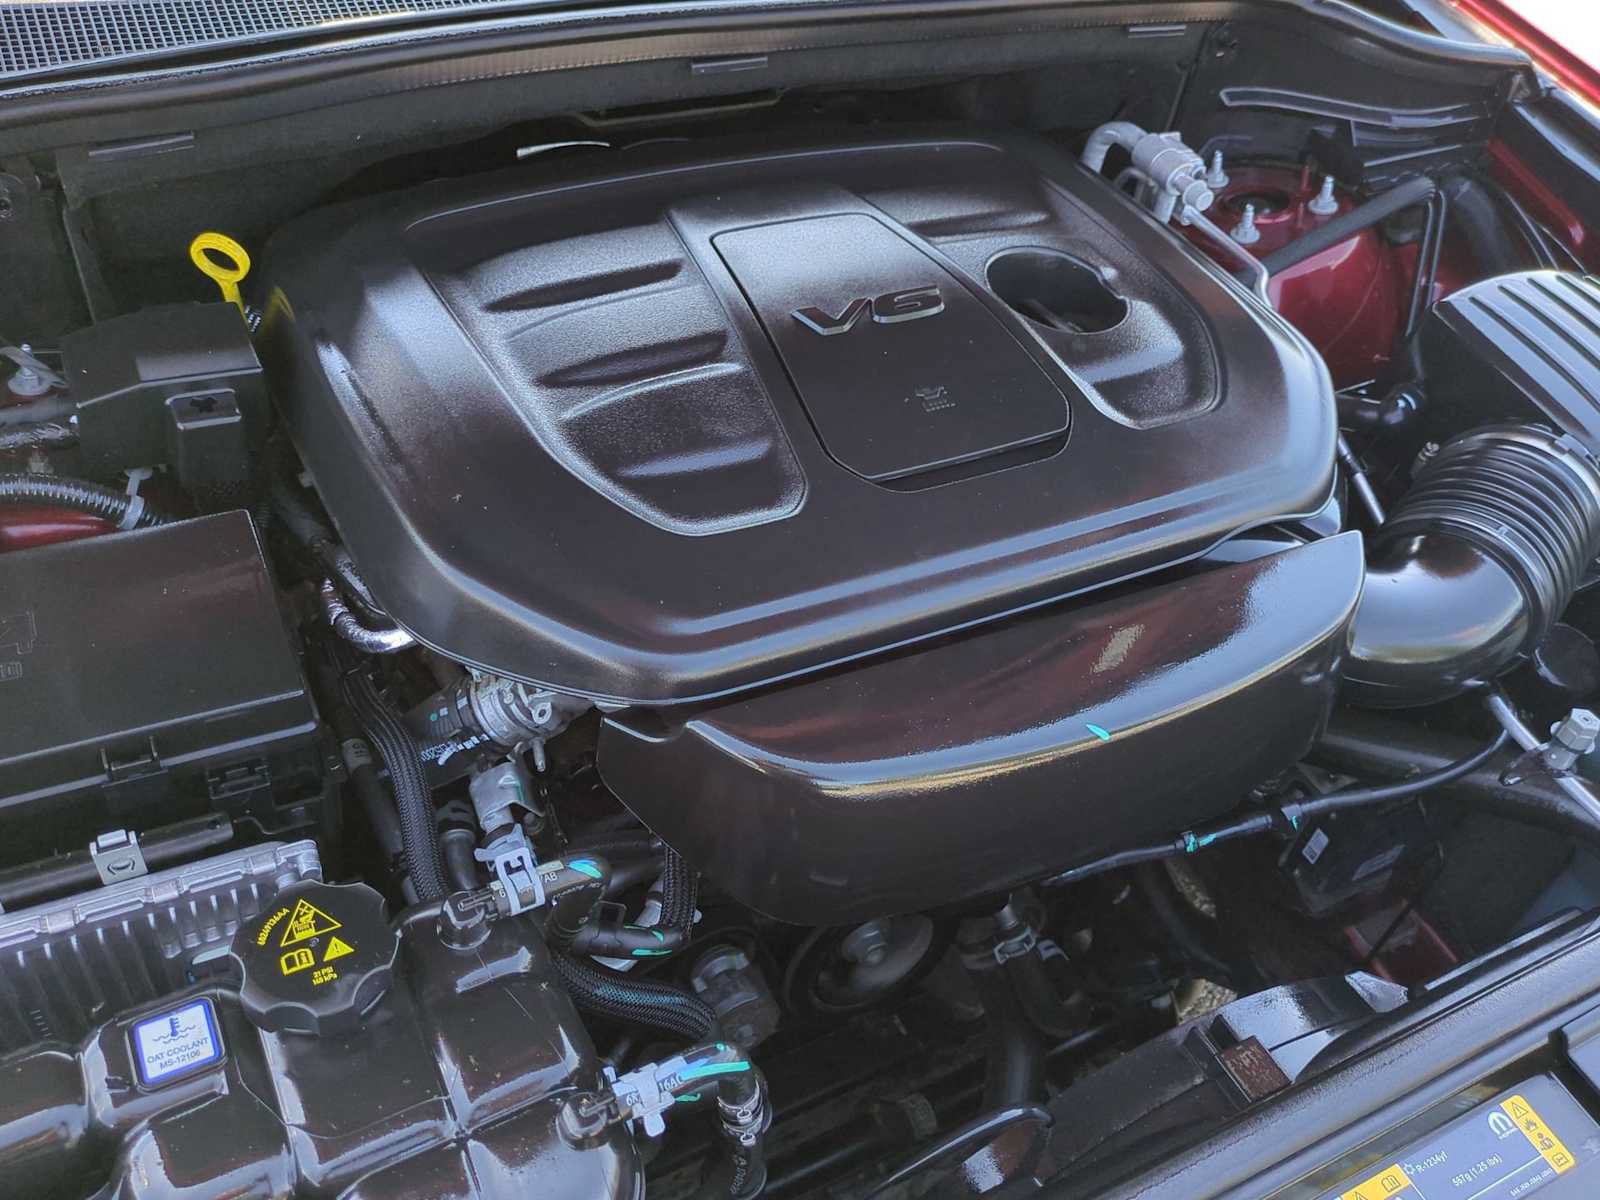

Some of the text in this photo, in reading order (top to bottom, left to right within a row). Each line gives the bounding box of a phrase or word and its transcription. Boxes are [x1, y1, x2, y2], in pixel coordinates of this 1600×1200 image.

[791, 285, 945, 336] V6
[147, 1037, 209, 1064] OAT COOLANT
